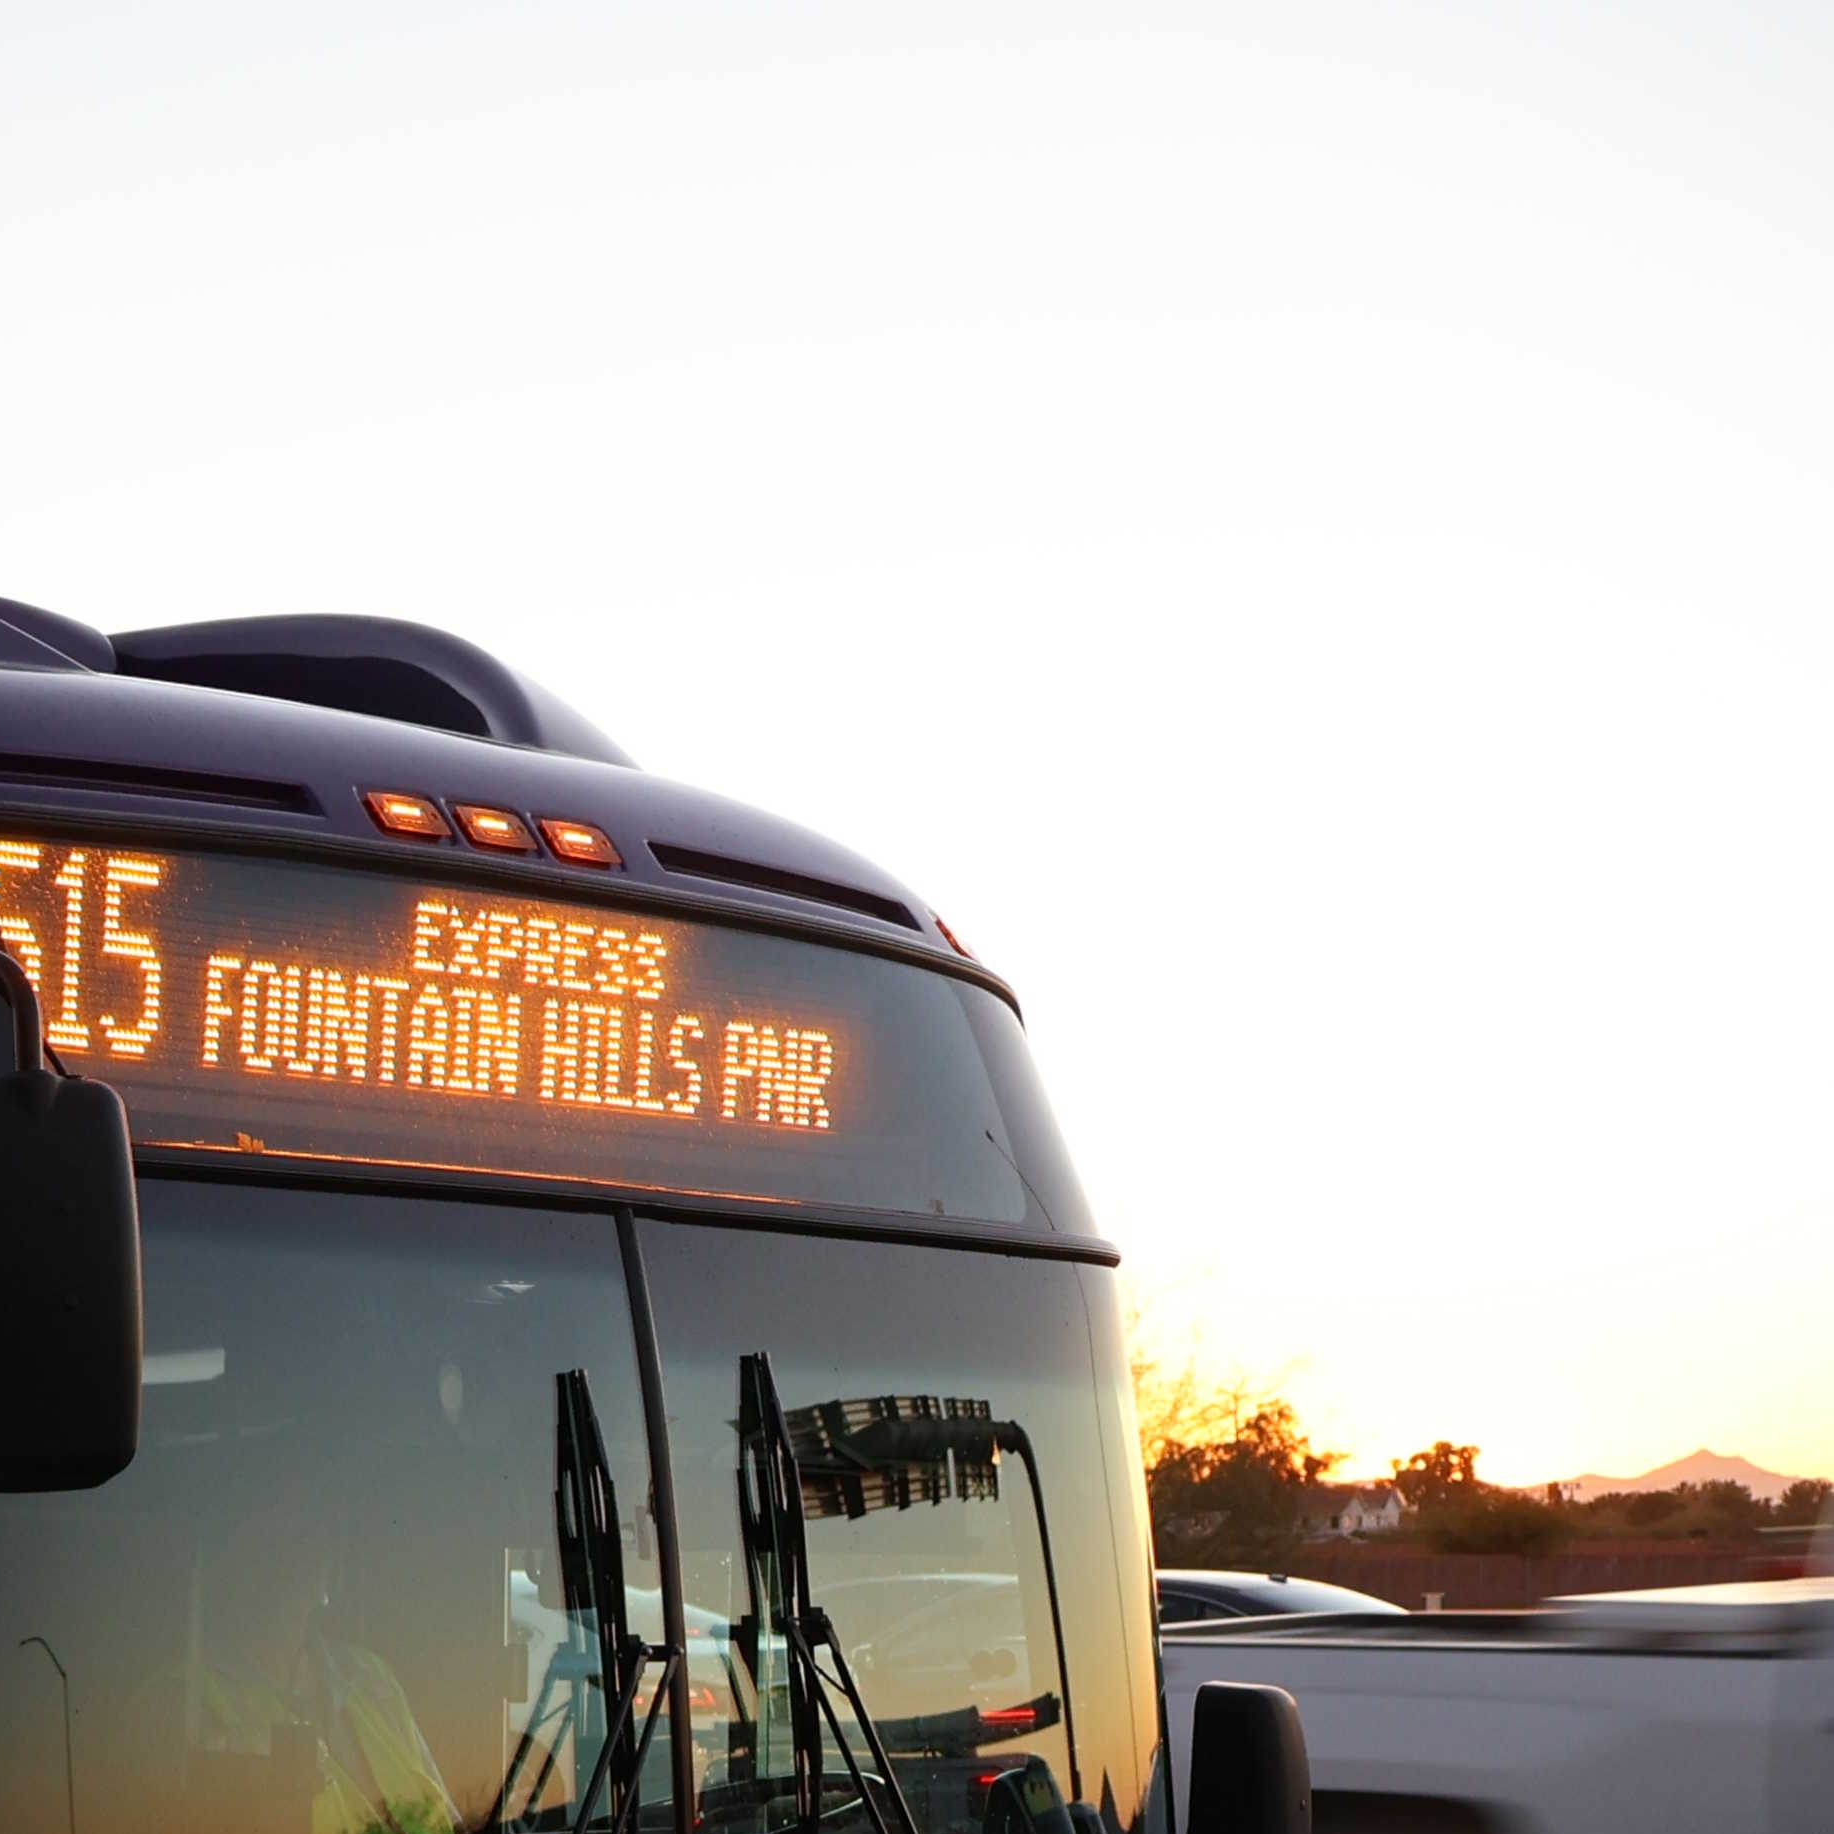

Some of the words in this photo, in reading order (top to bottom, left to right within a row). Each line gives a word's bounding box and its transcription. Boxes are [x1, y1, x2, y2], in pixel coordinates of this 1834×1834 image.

[413, 899, 667, 1000] EXPRESS
[202, 953, 521, 1095] FOUNTAIN
[540, 997, 705, 1115] HILLS
[722, 1020, 833, 1129] PNR
